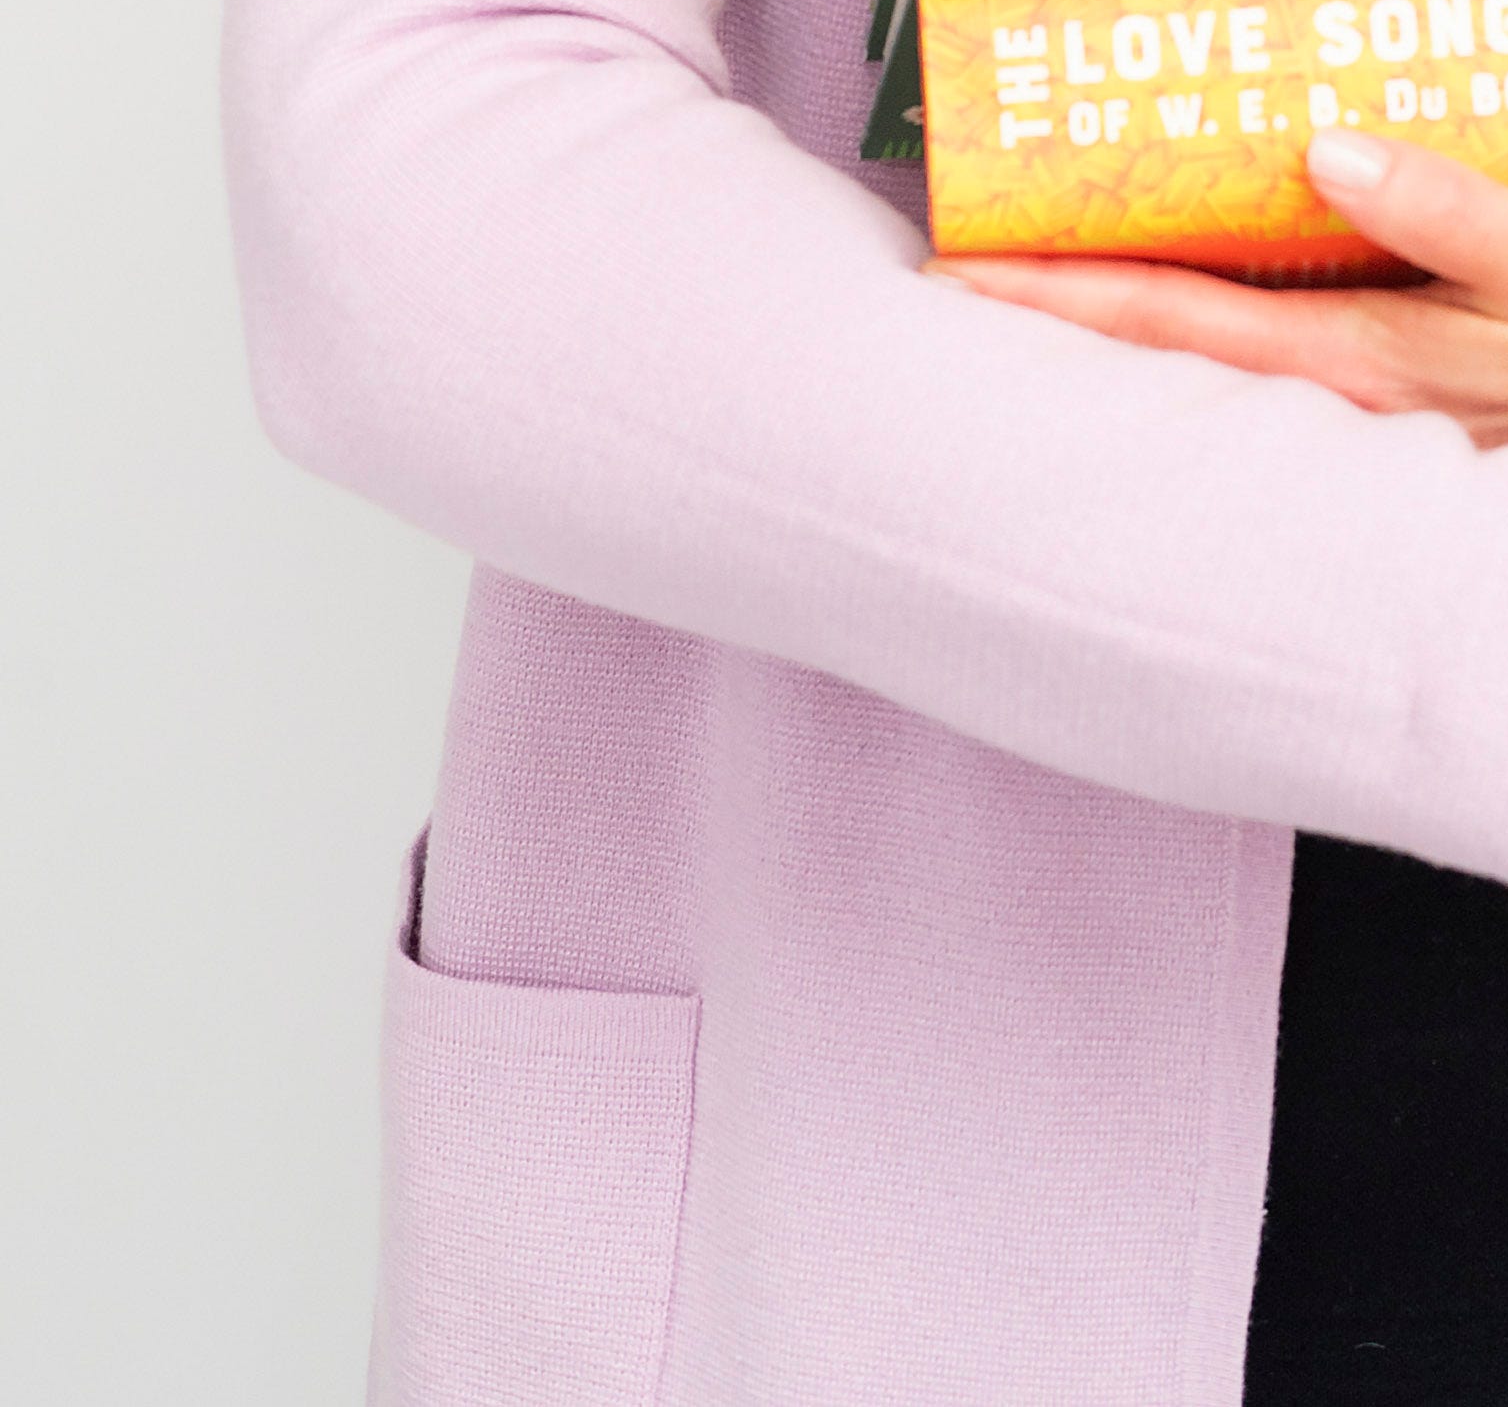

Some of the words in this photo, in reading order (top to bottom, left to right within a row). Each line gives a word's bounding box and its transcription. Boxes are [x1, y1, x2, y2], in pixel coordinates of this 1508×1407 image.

[1063, 5, 1273, 85] LOVE
[993, 24, 1054, 150] THE
[1066, 96, 1132, 148] OF
[1155, 91, 1221, 141] W.
[1236, 87, 1291, 135] E.
[1307, 81, 1363, 131] B.
[1384, 75, 1449, 122] Du
